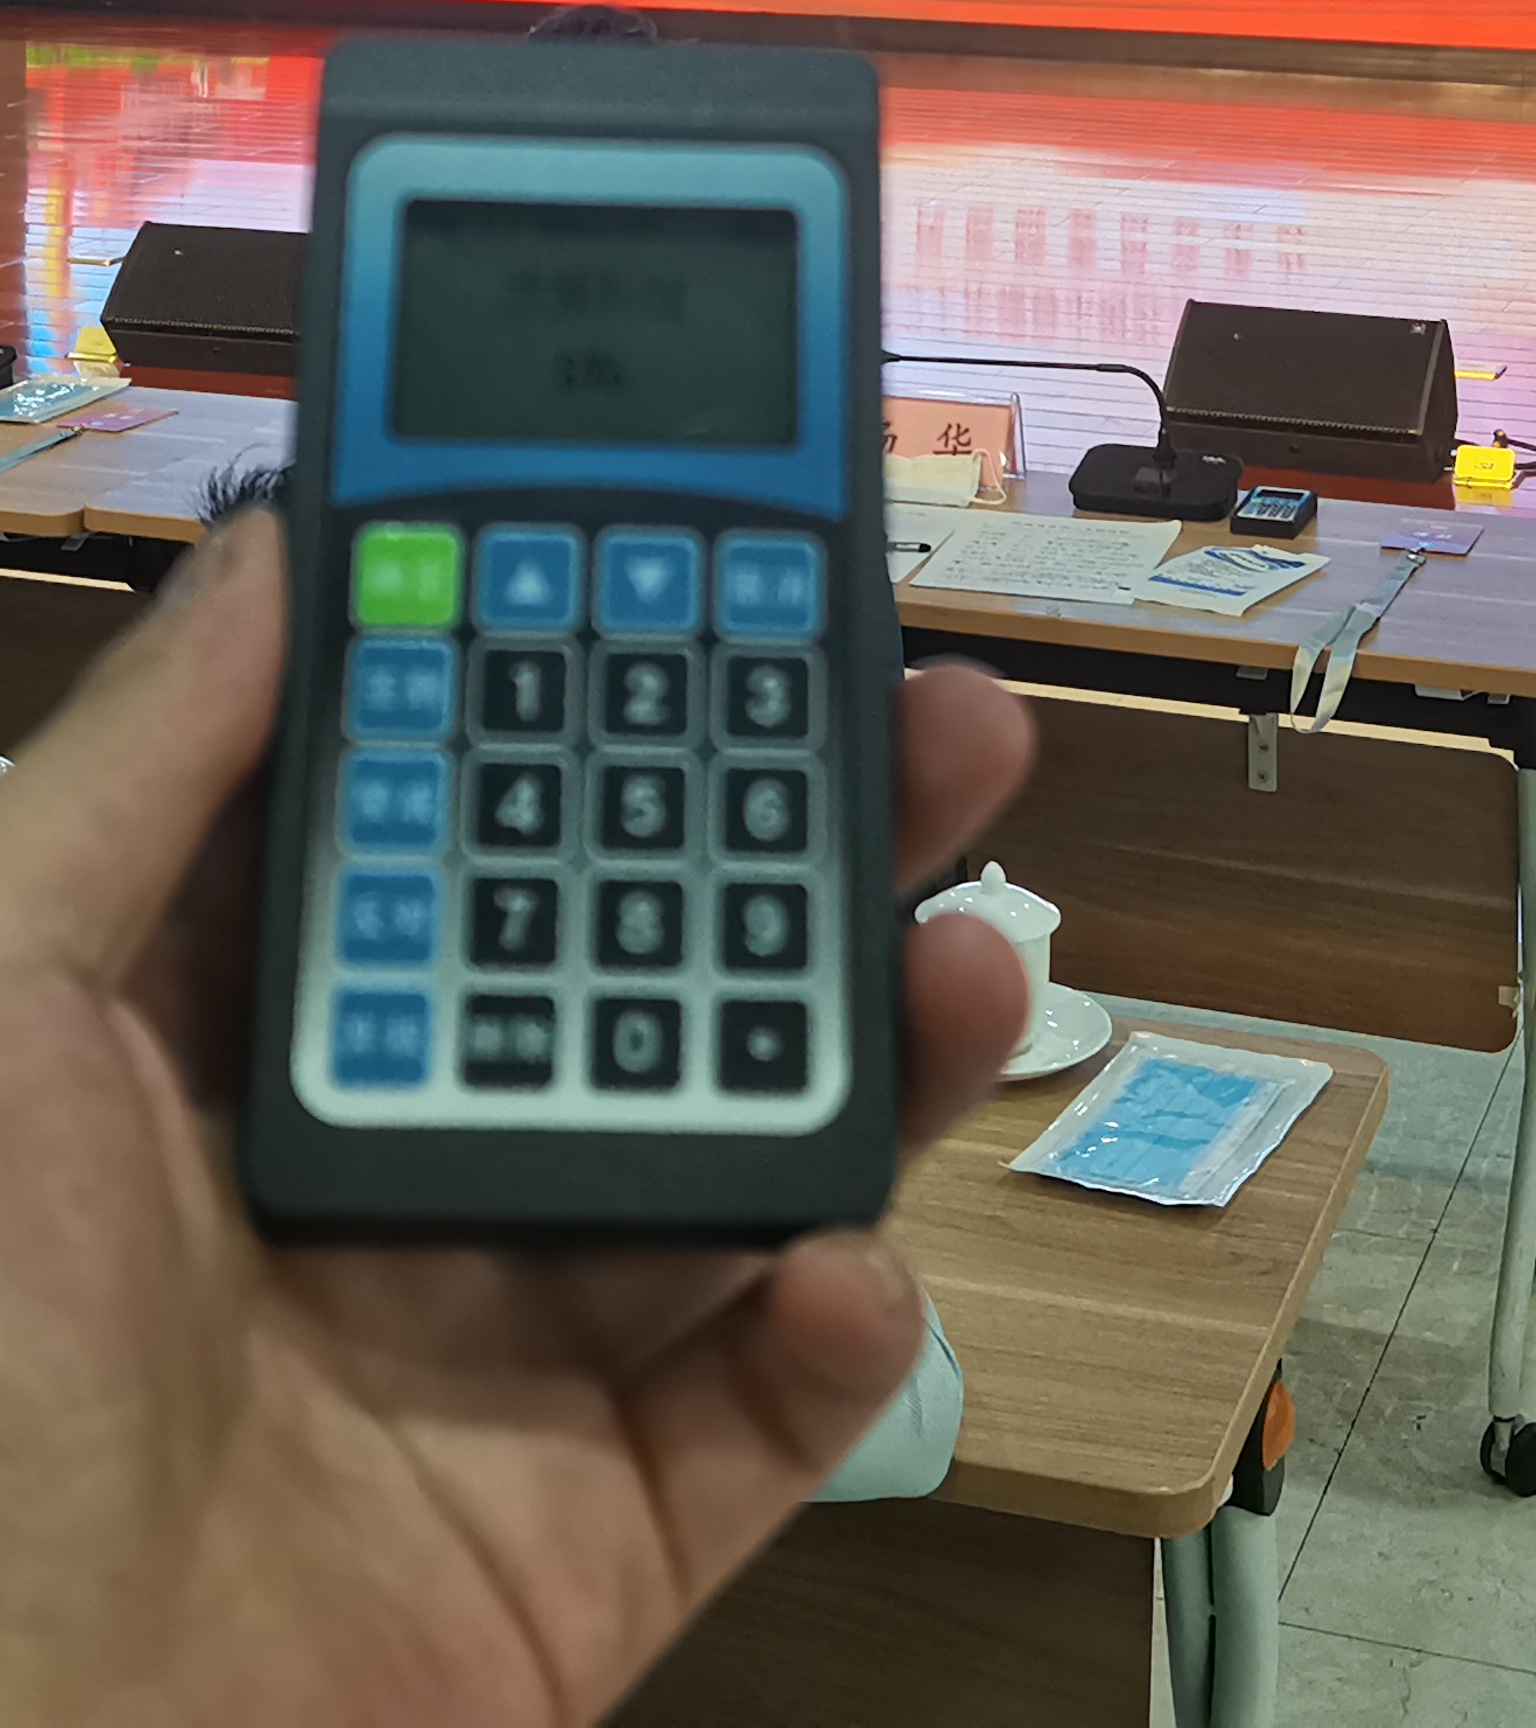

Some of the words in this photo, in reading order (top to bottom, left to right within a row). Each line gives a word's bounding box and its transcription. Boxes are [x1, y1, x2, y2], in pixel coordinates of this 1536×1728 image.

[511, 658, 542, 723] 1
[622, 662, 670, 727] 2
[744, 663, 792, 728] 3
[494, 772, 544, 837] 4
[620, 774, 667, 839] 5
[742, 777, 792, 842] 6
[492, 886, 540, 952] 7
[615, 889, 665, 955] 8
[742, 892, 791, 958] 9
[612, 1008, 662, 1074] 0
